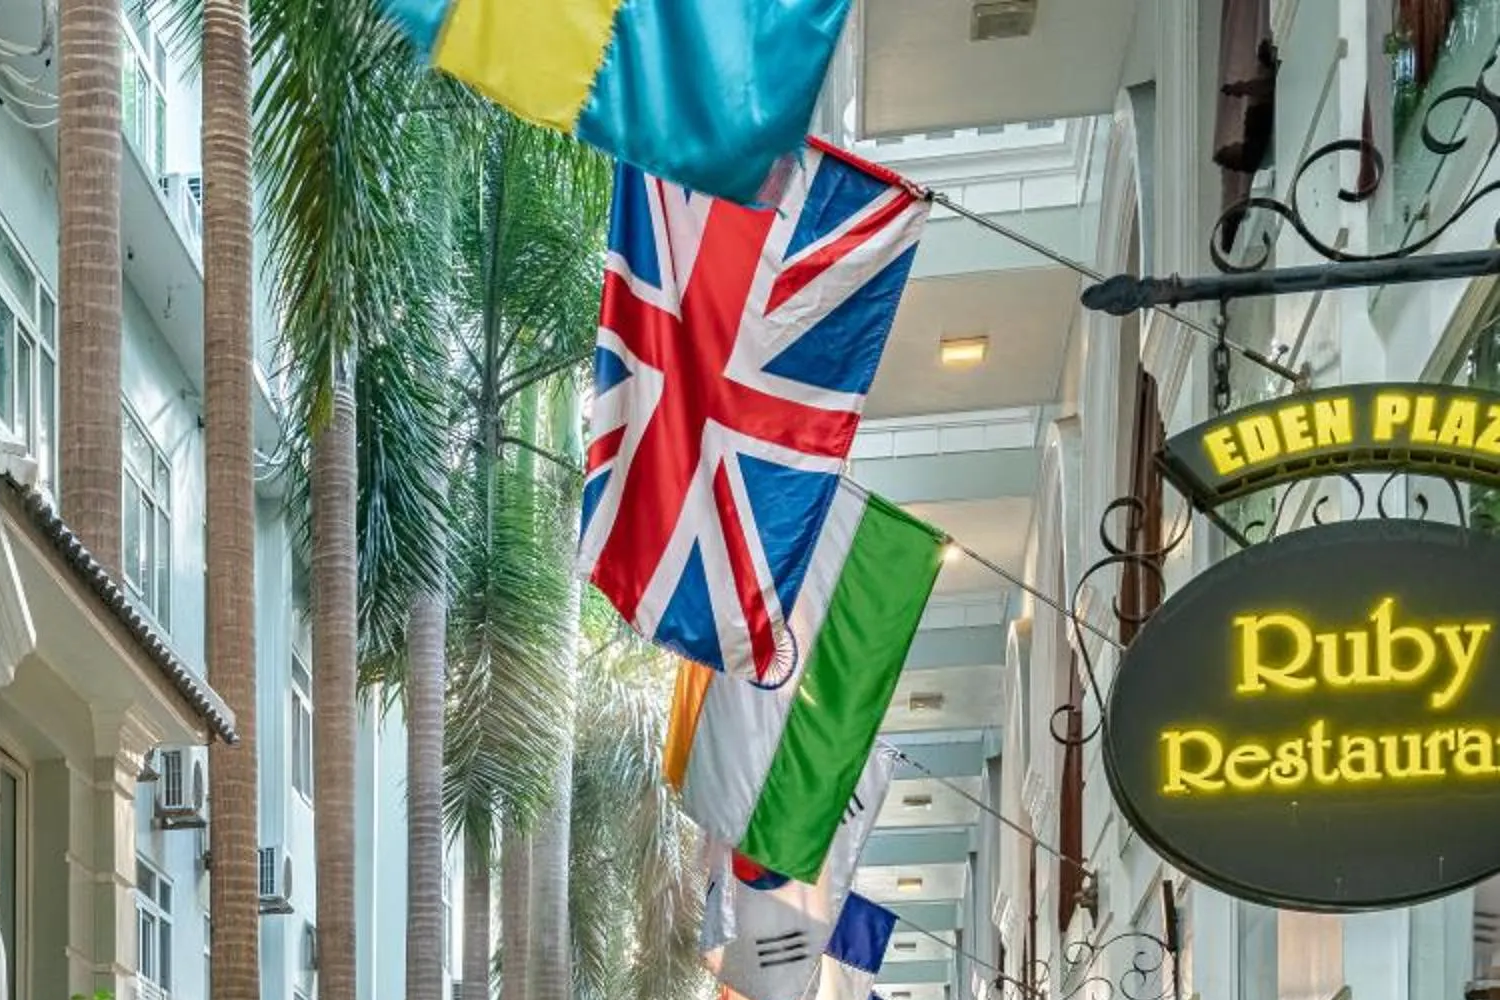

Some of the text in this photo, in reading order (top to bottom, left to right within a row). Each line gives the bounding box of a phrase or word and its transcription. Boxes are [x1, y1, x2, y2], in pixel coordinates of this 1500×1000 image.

[1203, 395, 1354, 475] EDEN
[1231, 597, 1490, 708] Ruby
[1160, 719, 1500, 794] Restaura
